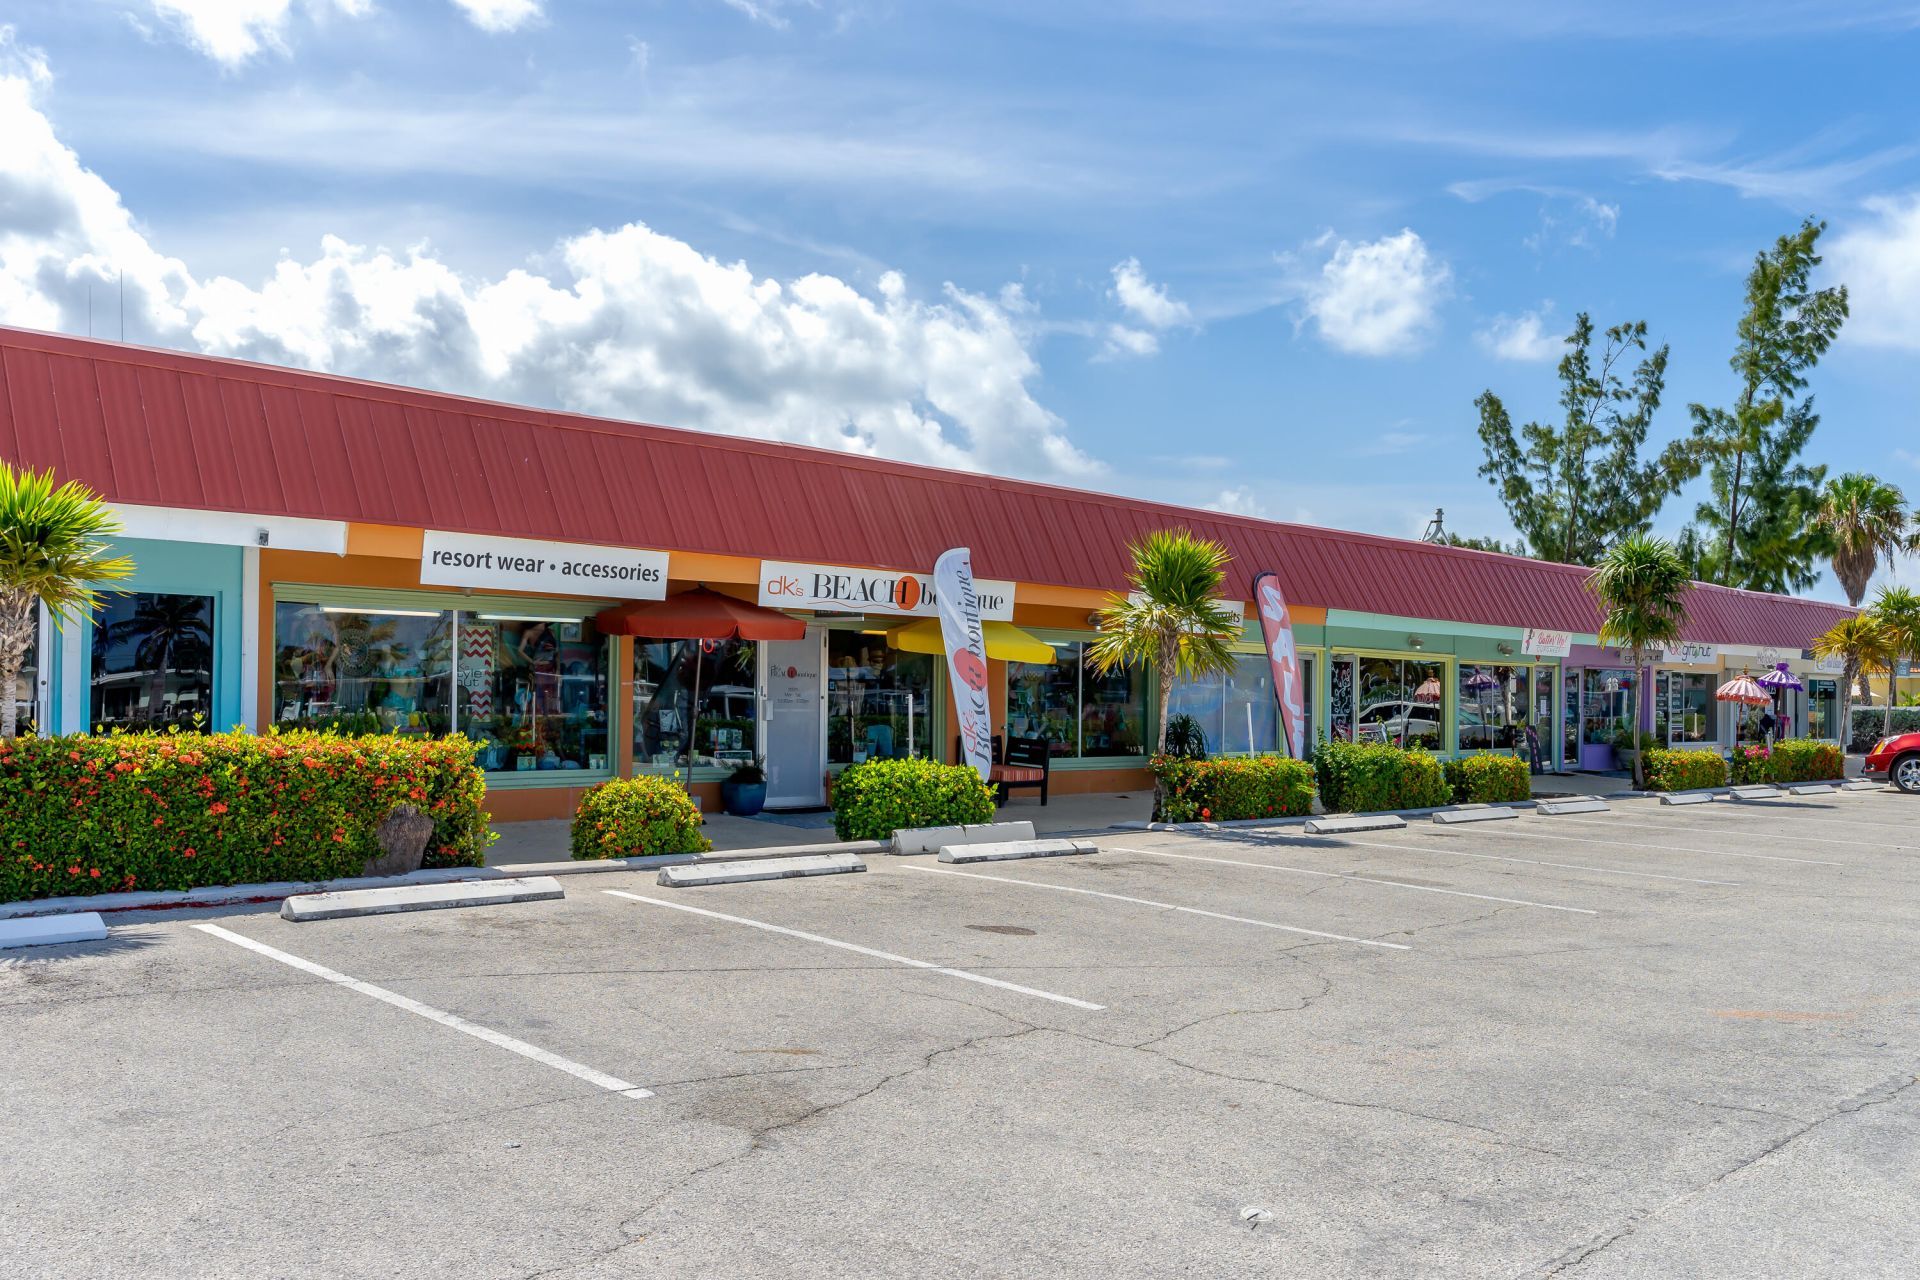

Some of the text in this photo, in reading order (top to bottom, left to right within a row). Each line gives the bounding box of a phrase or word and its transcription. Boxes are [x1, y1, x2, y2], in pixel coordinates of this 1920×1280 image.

[432, 550, 660, 582] resort wear accessories
[767, 576, 804, 597] dk's
[808, 573, 908, 604] BEACH
[957, 570, 981, 657] boutique
